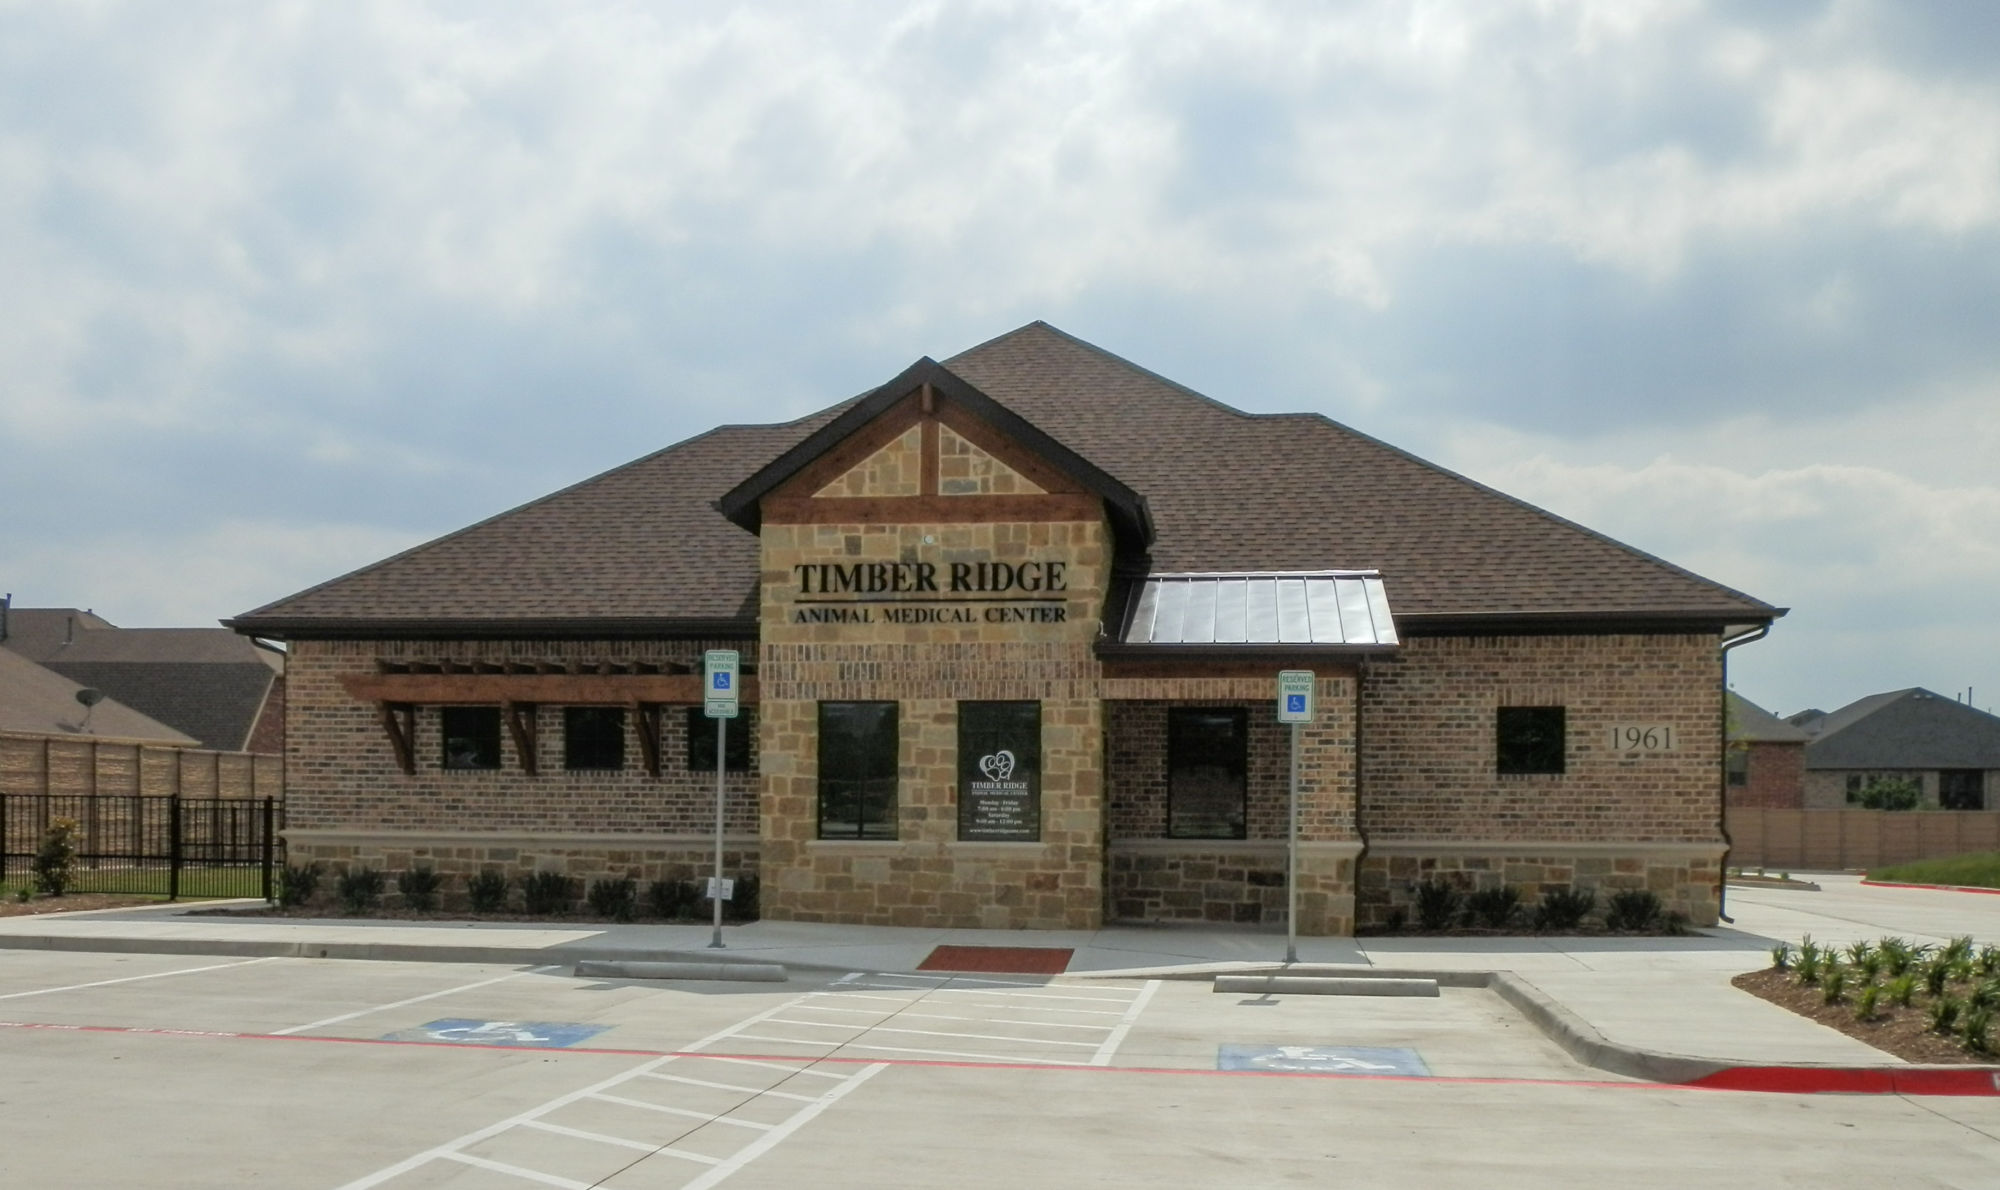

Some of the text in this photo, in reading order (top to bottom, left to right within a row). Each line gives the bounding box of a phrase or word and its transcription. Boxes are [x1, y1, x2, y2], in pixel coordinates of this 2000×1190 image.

[794, 561, 1068, 593] TIMBER RIDGE
[794, 606, 1067, 624] ANIMAL MEDICAL CENTER
[1282, 675, 1312, 683] RESERVED
[1613, 726, 1672, 750] 1961
[971, 781, 1028, 790] TIMBER RIDGE
